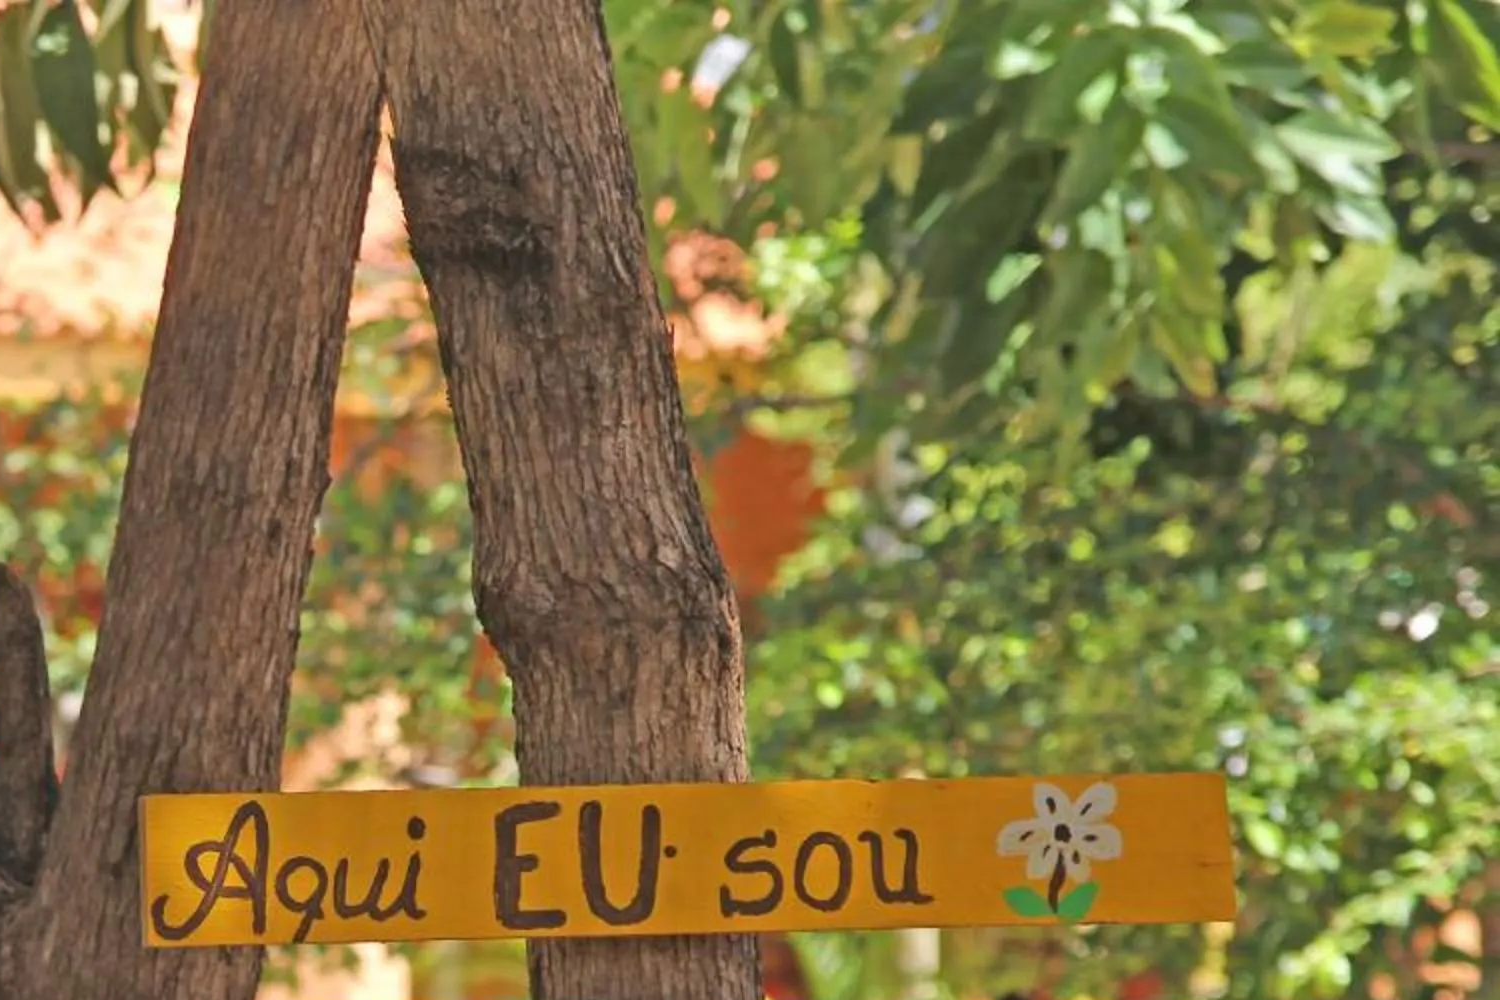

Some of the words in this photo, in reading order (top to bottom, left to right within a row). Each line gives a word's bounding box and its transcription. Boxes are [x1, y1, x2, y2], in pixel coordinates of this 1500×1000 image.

[151, 800, 426, 942] Aqui
[494, 801, 662, 929] EU
[719, 828, 933, 917] sou
